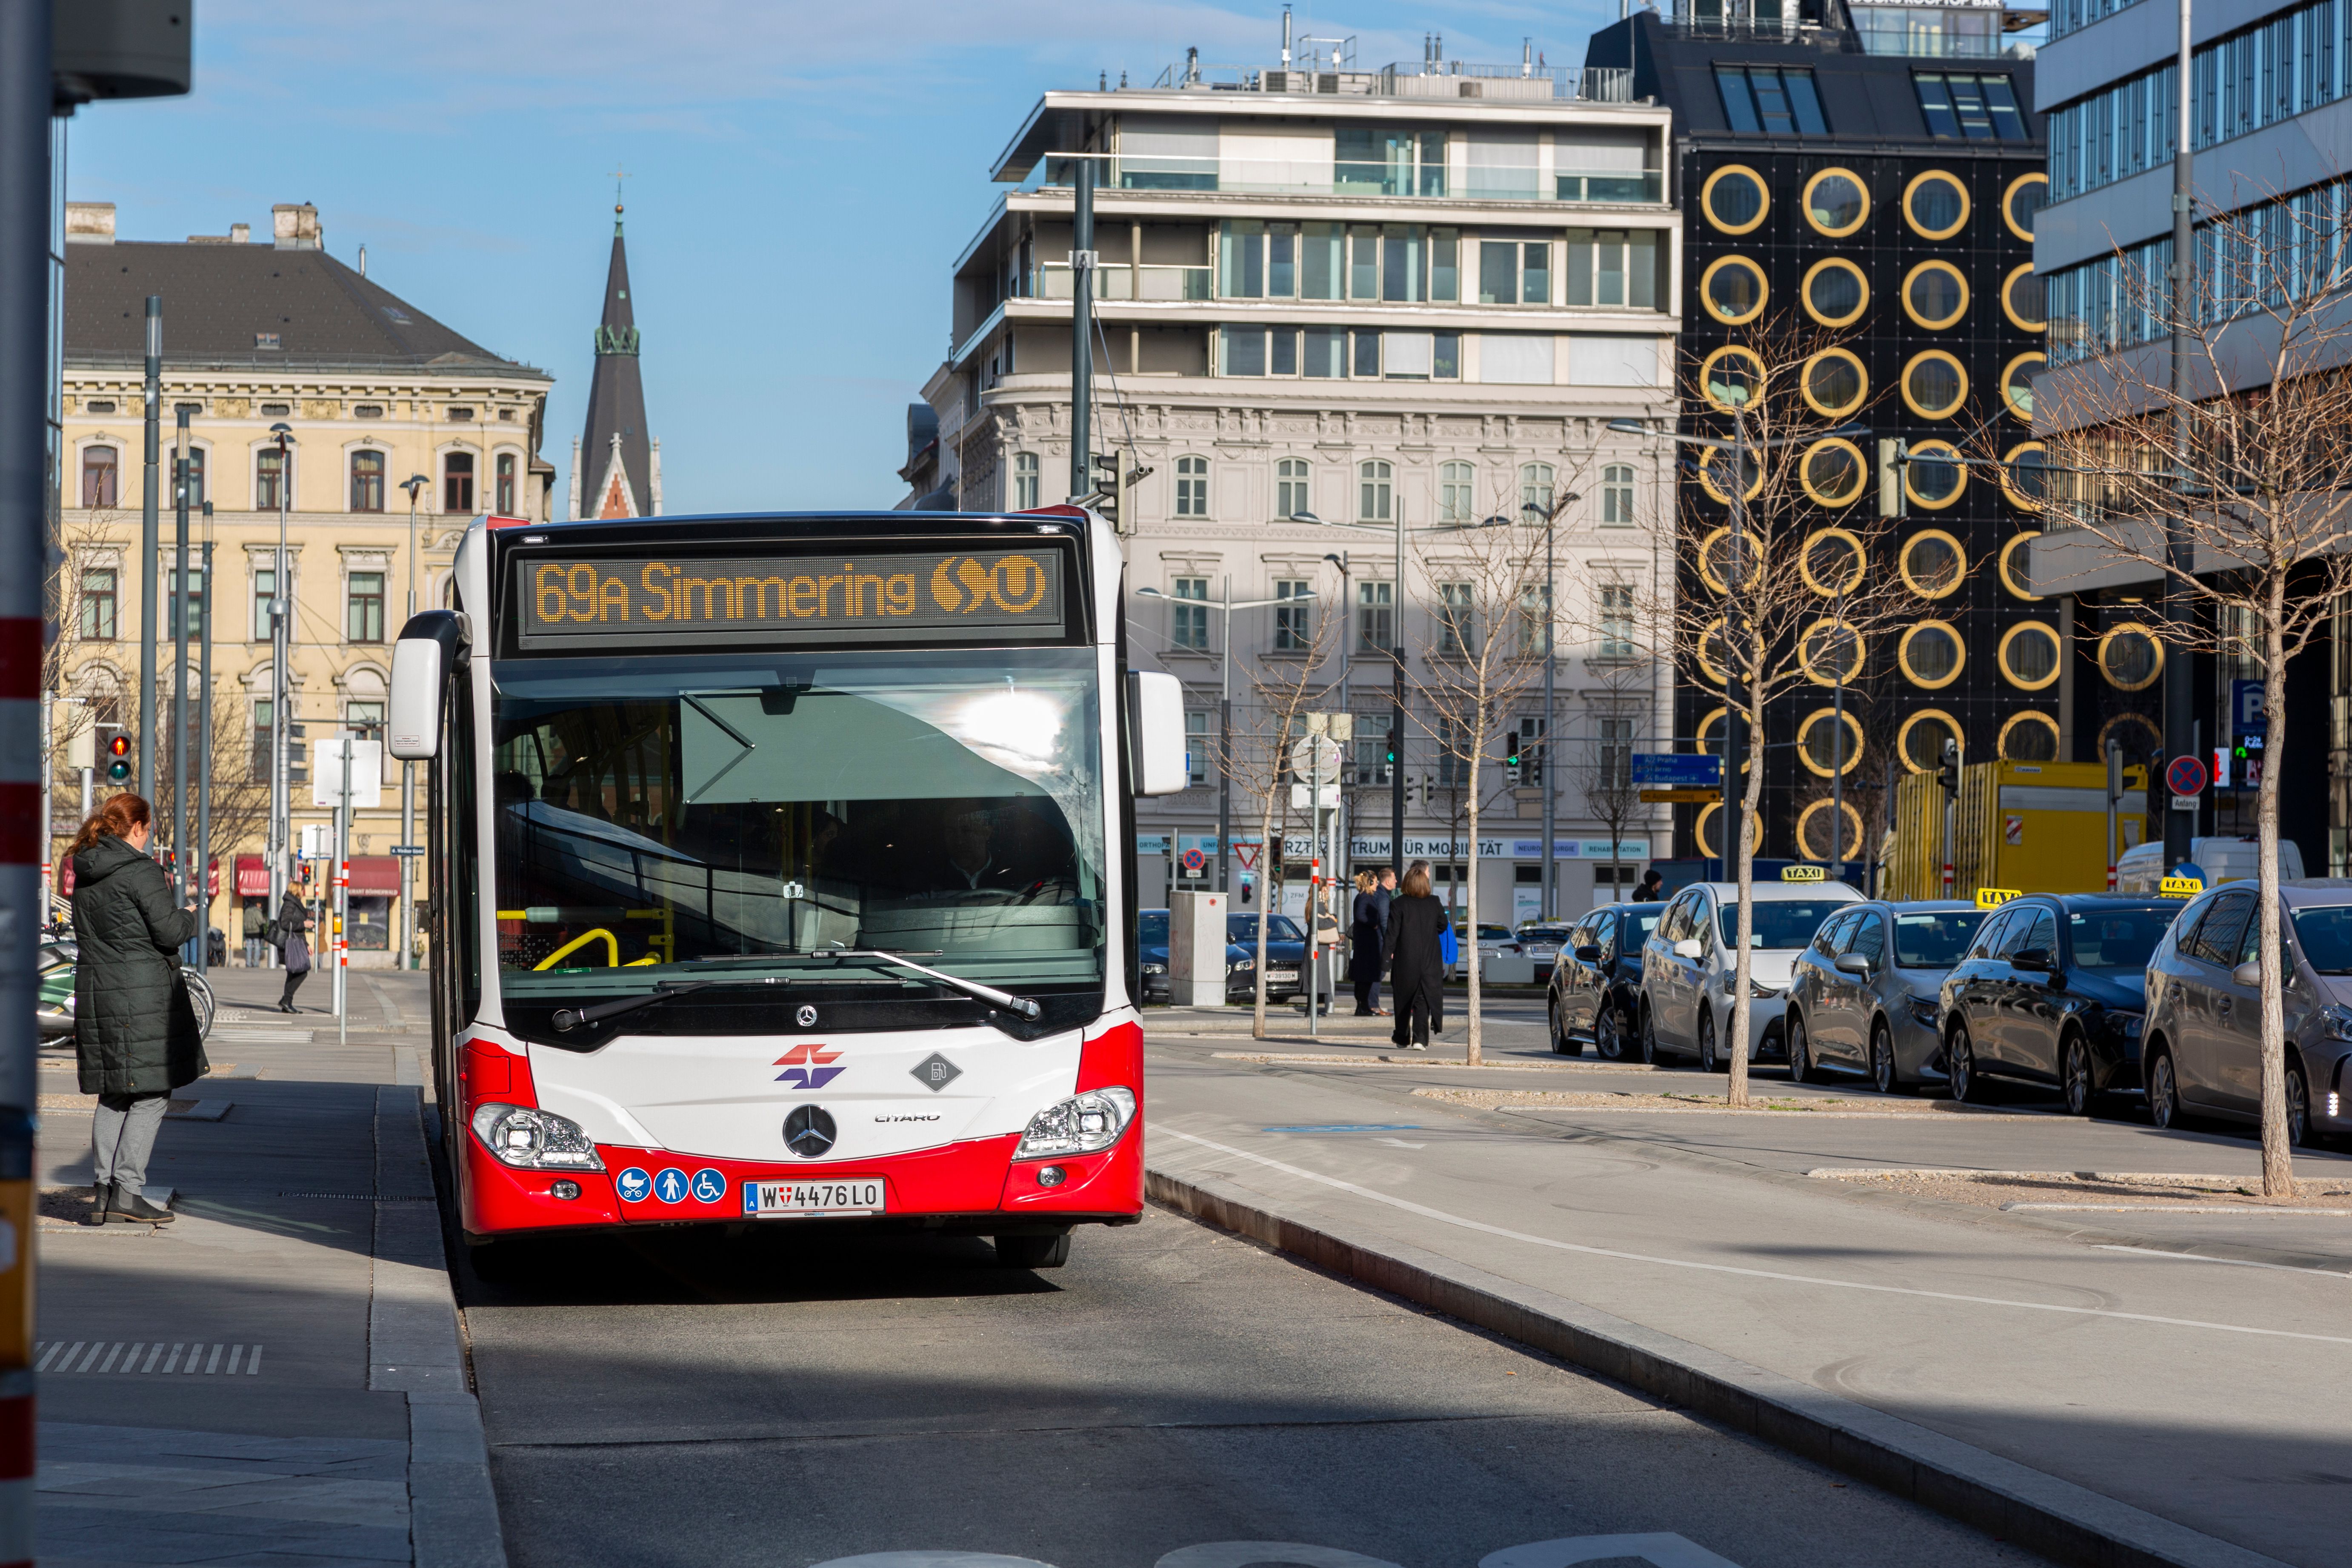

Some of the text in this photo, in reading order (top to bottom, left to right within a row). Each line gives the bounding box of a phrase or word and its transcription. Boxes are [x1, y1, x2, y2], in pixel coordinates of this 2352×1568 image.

[536, 564, 629, 622] 69A
[642, 562, 915, 620] Simmering
[1655, 774, 1687, 783] Budapest
[2175, 799, 2197, 808] Anfang
[1404, 839, 1423, 854] ÜR
[1429, 840, 1503, 855] MOBILTÄT
[1788, 868, 1819, 877] TAXI
[2167, 880, 2196, 889] TAXI
[874, 1111, 941, 1122] CITARO
